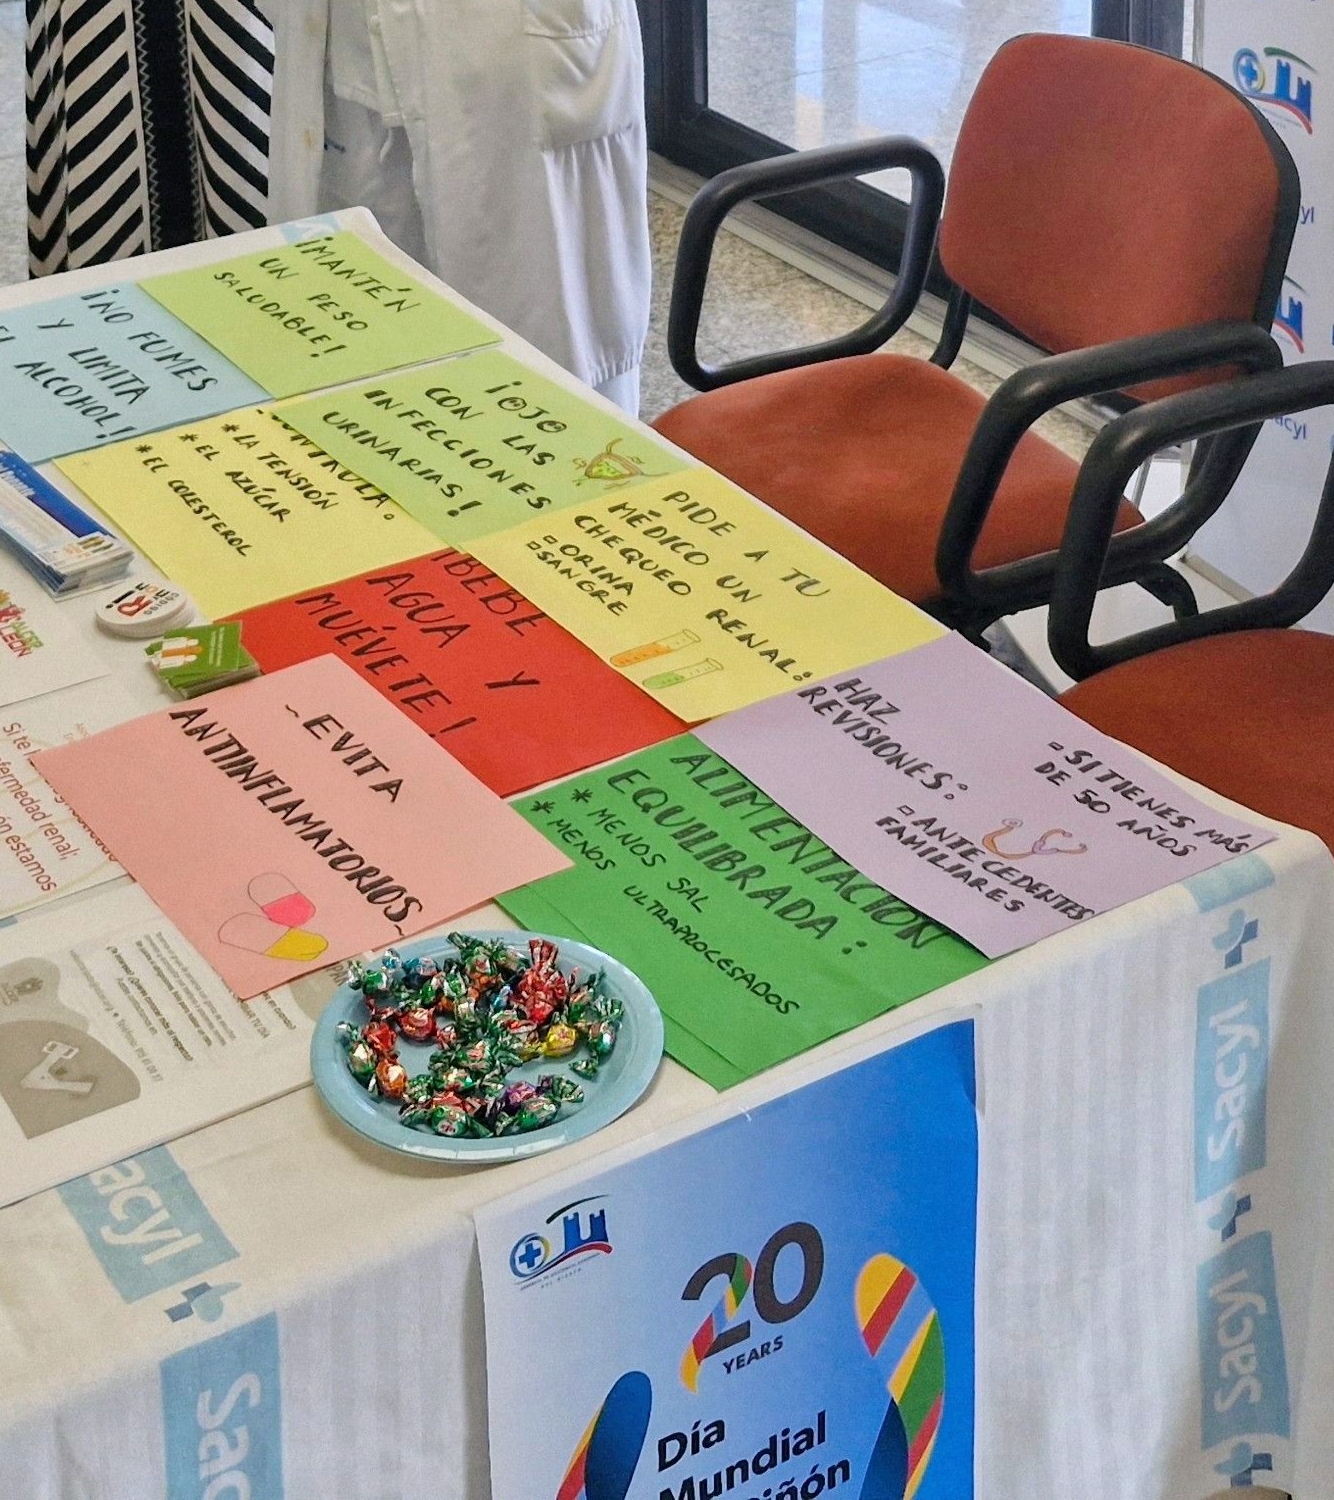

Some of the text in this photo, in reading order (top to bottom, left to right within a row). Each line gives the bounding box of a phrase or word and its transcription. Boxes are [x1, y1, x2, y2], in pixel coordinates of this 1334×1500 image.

[214, 272, 347, 357] SALUDABLE!
[259, 258, 368, 330] UN PESO
[295, 237, 420, 312] ¡MANTÉN
[38, 318, 149, 404] Y LIMITA
[81, 290, 218, 391] ¡NO FUMES
[14, 362, 136, 439] ALCOHOL!
[425, 388, 555, 465] CON LAS
[195, 445, 290, 522] EL AZÚCAR
[233, 435, 338, 509] LA TENSIÓN
[364, 390, 551, 509] INFECCIONES
[143, 457, 251, 556] EL COLESTEROL
[662, 491, 830, 596] PIDE A TU
[536, 551, 628, 616] SANGRE
[559, 544, 633, 596] ORINA
[575, 516, 691, 595] CHEQUEO
[608, 502, 762, 602] MÉDICO UN
[365, 573, 540, 689] AGUA Y
[797, 686, 968, 800] REVISIONES:
[822, 678, 900, 725] HAZ
[39, 823, 80, 860] renal;
[1035, 762, 1197, 856] DE 50 AÑOS
[1197, 825, 1251, 854] MÁS
[5, 835, 57, 891] estamos
[587, 808, 708, 913] MENOS SAL
[607, 769, 867, 955] EQUILIBRADA:
[875, 816, 1025, 912] FAMILIARES
[911, 818, 1099, 920] ANTECEDENTES
[547, 819, 800, 1014] MENOS ULTRAPROCESADOS
[1208, 1000, 1250, 1166] Sacyl
[681, 1221, 825, 1362] 20
[723, 1335, 784, 1375] YEARS
[1214, 1280, 1263, 1416] Sacyl
[658, 1419, 726, 1472] Día
[659, 1409, 827, 1500] Mundial
